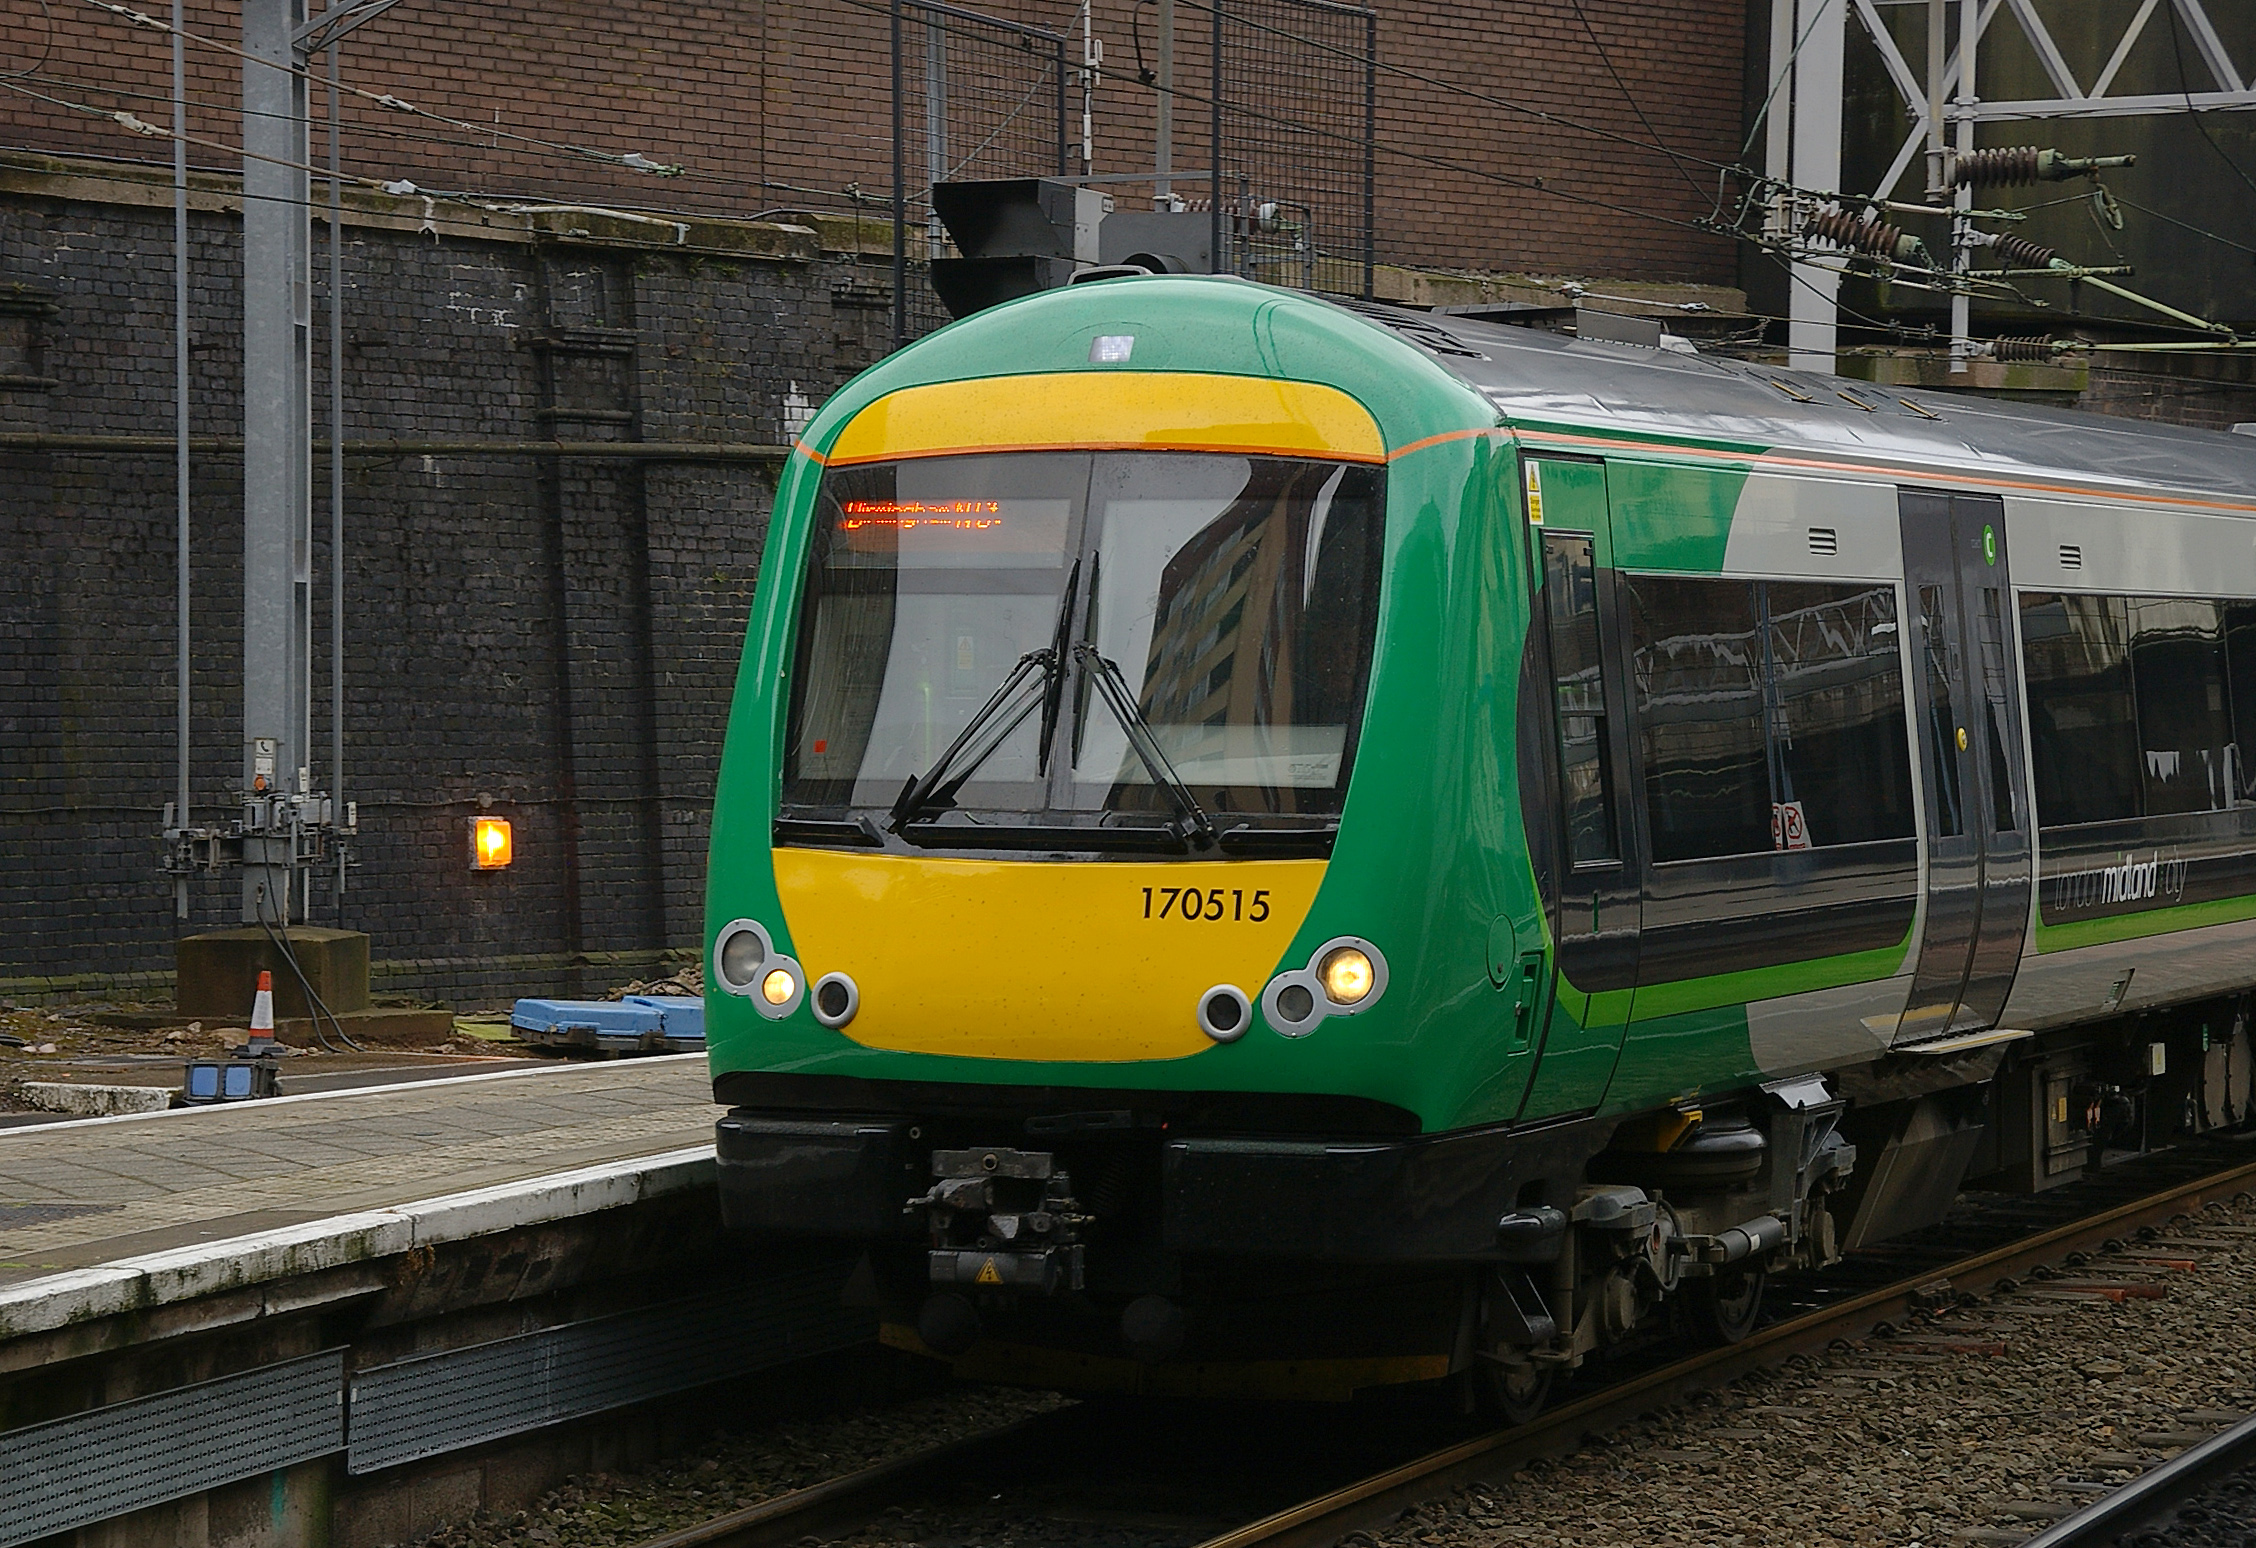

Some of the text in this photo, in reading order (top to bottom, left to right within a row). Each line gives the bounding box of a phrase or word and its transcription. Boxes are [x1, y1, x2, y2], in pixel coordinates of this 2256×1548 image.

[2101, 850, 2158, 904] midland
[2165, 844, 2188, 903] city
[1141, 887, 1271, 923] 170515
